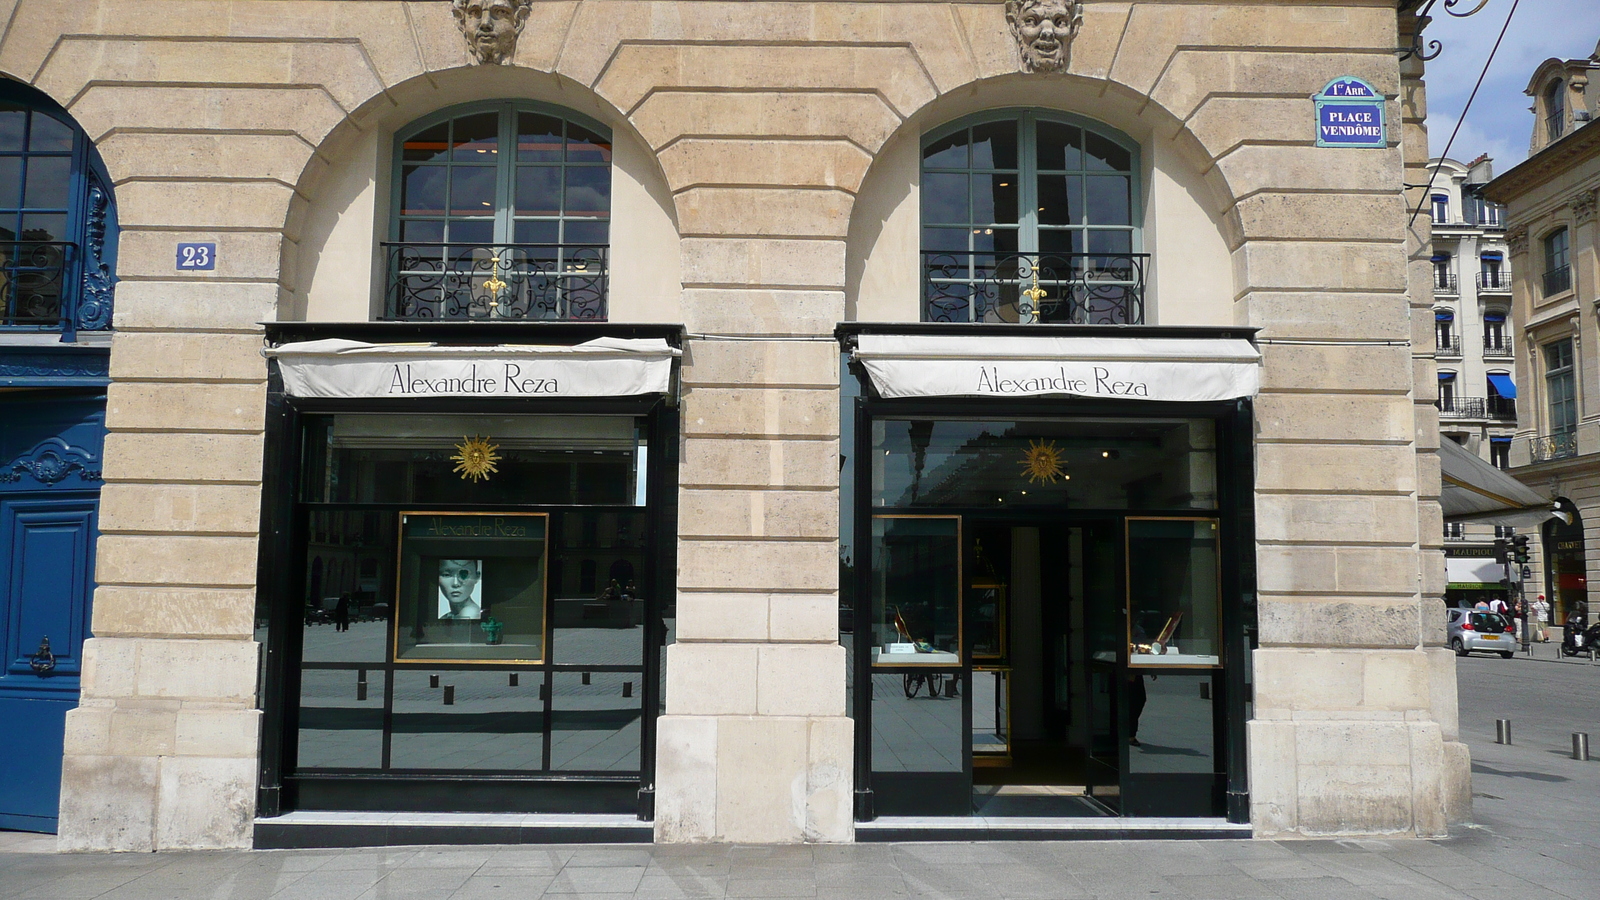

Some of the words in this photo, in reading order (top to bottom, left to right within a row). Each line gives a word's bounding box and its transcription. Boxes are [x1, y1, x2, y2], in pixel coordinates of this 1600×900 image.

[1329, 112, 1372, 123] PLACE
[1321, 123, 1381, 136] VENDÔME
[182, 246, 209, 267] 23
[388, 364, 497, 394] Alexandre
[504, 363, 558, 394] Reza
[976, 366, 1088, 393] Alexandre
[1093, 366, 1149, 397] Reza
[427, 517, 492, 536] Alexandre
[494, 517, 526, 537] Reza
